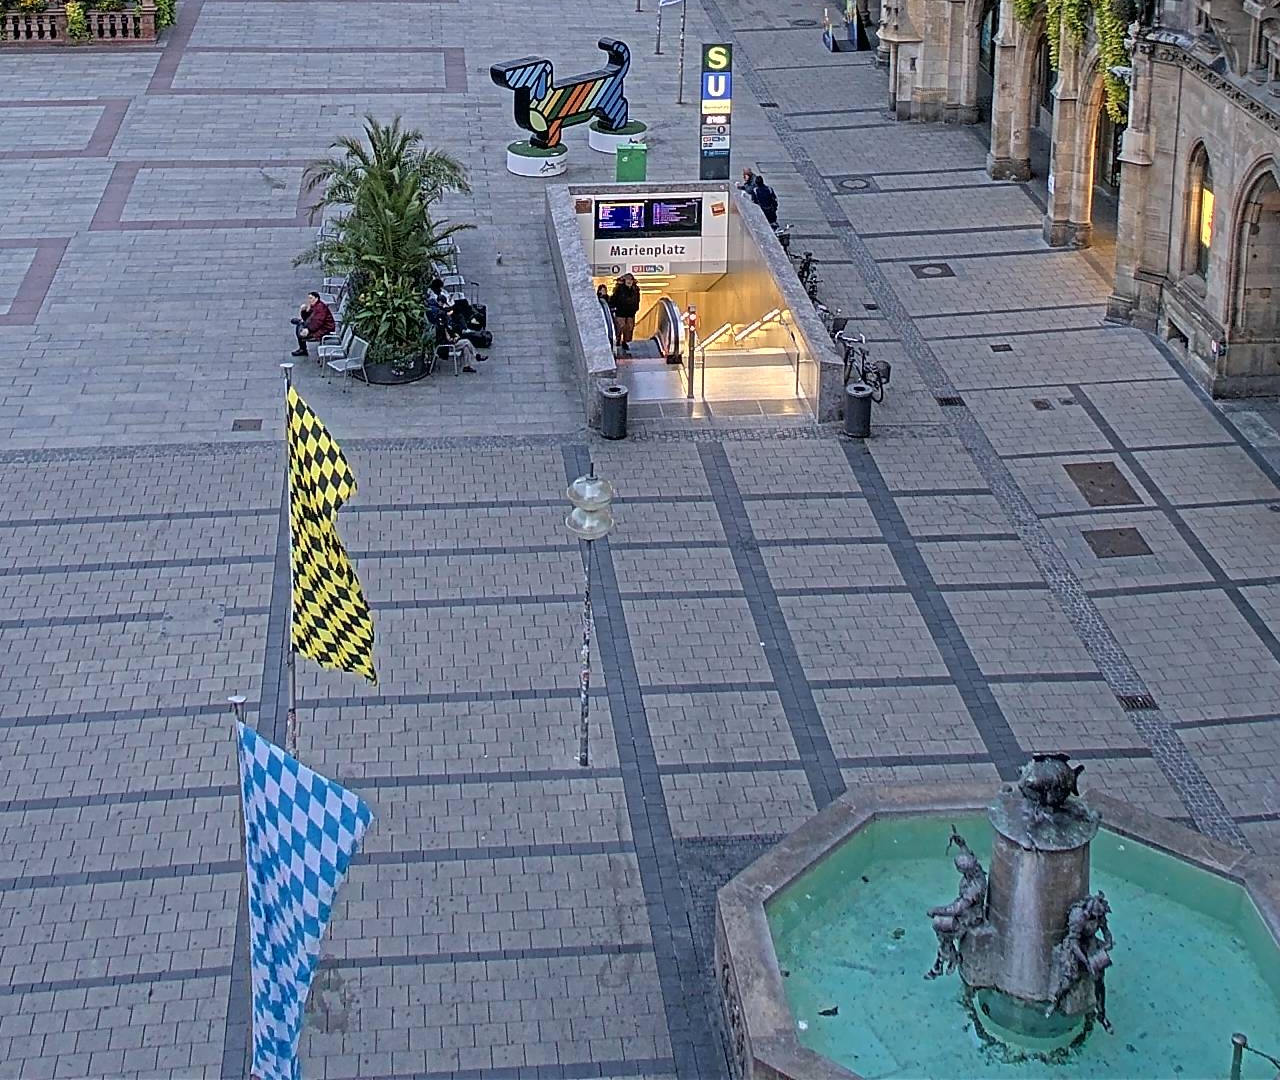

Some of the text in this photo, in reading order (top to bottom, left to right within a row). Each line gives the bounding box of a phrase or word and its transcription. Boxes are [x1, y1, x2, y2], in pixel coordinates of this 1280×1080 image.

[708, 46, 727, 69] S
[708, 75, 726, 97] U
[610, 244, 686, 258] Marienplatz
